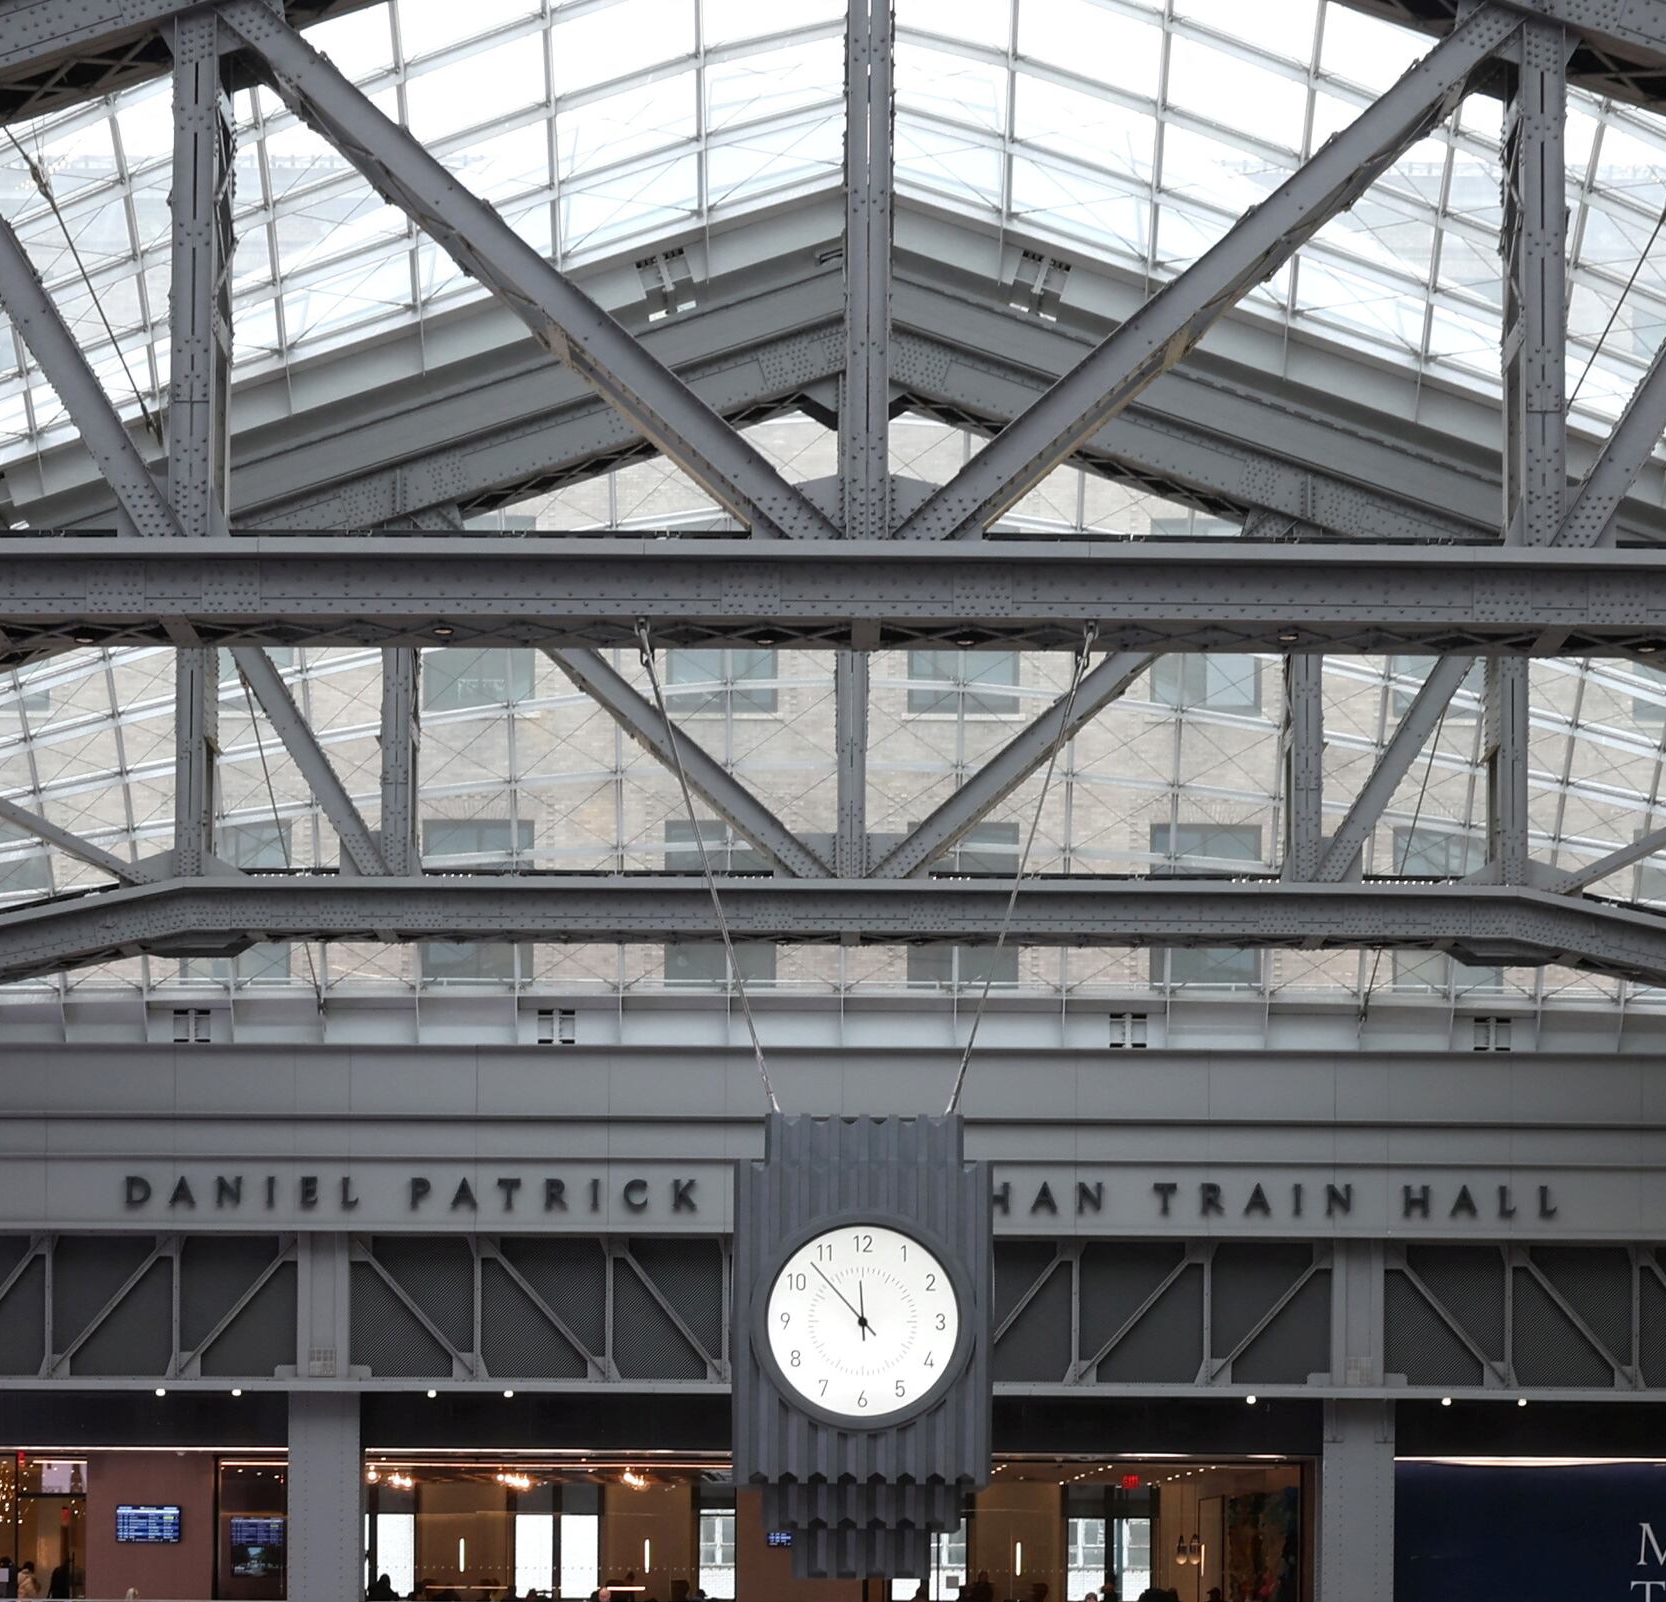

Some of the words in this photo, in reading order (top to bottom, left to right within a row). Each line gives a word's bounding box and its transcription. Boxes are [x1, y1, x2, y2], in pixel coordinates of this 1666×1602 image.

[125, 1175, 359, 1210] DANIEL
[411, 1176, 699, 1212] PATRICK
[1153, 1182, 1354, 1217] TRAIN
[1403, 1184, 1559, 1219] HALL
[816, 1244, 833, 1262] 11
[853, 1235, 874, 1253] 12
[900, 1245, 908, 1262] 1
[786, 1273, 807, 1291] 10
[925, 1273, 937, 1291] 2
[780, 1312, 791, 1330] 9
[935, 1313, 946, 1331] 3
[790, 1350, 801, 1367] 8
[924, 1351, 935, 1368] 4
[818, 1379, 829, 1397] 7
[895, 1380, 906, 1397] 5
[857, 1390, 868, 1408] 6
